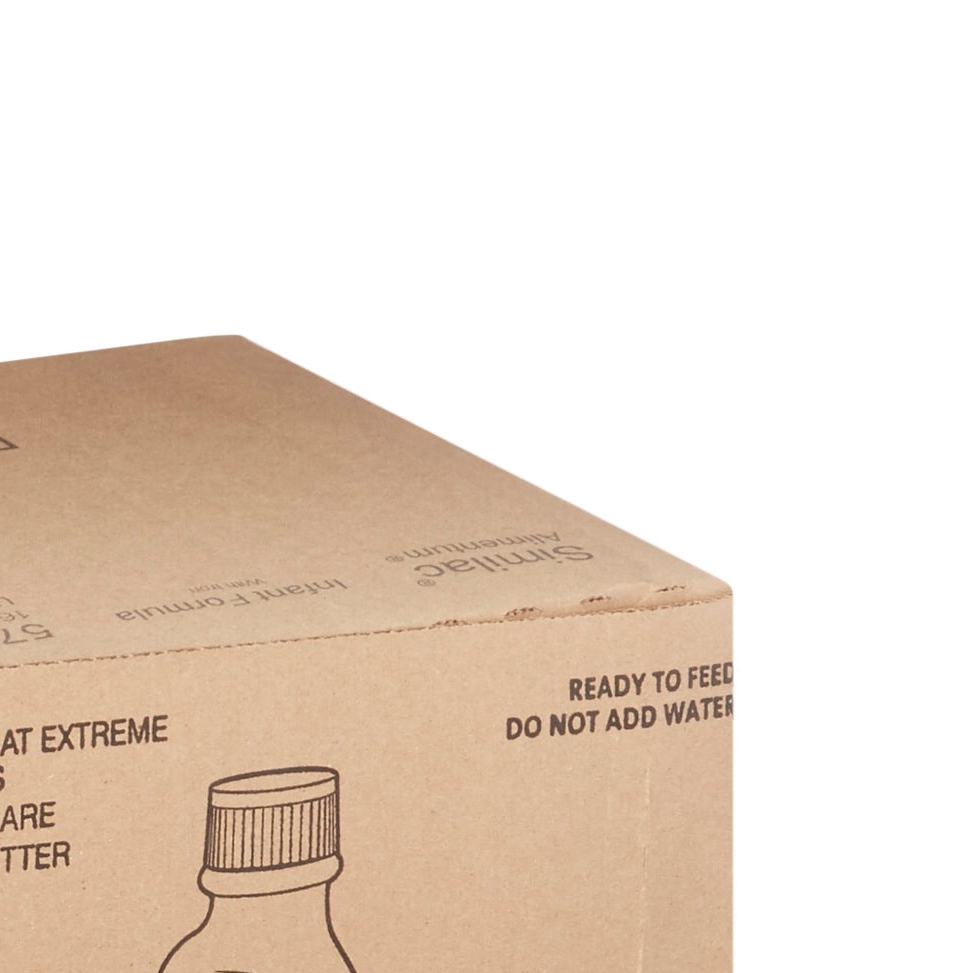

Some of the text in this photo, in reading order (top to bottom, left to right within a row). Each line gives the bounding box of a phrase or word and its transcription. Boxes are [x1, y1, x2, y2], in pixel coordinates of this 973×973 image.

[115, 578, 348, 621] Infant Formula
[569, 661, 733, 702] READY TO FEED
[0, 727, 34, 756] AT
[41, 714, 169, 753] EXTREME
[506, 694, 733, 741] DO NOT ADD WATER
